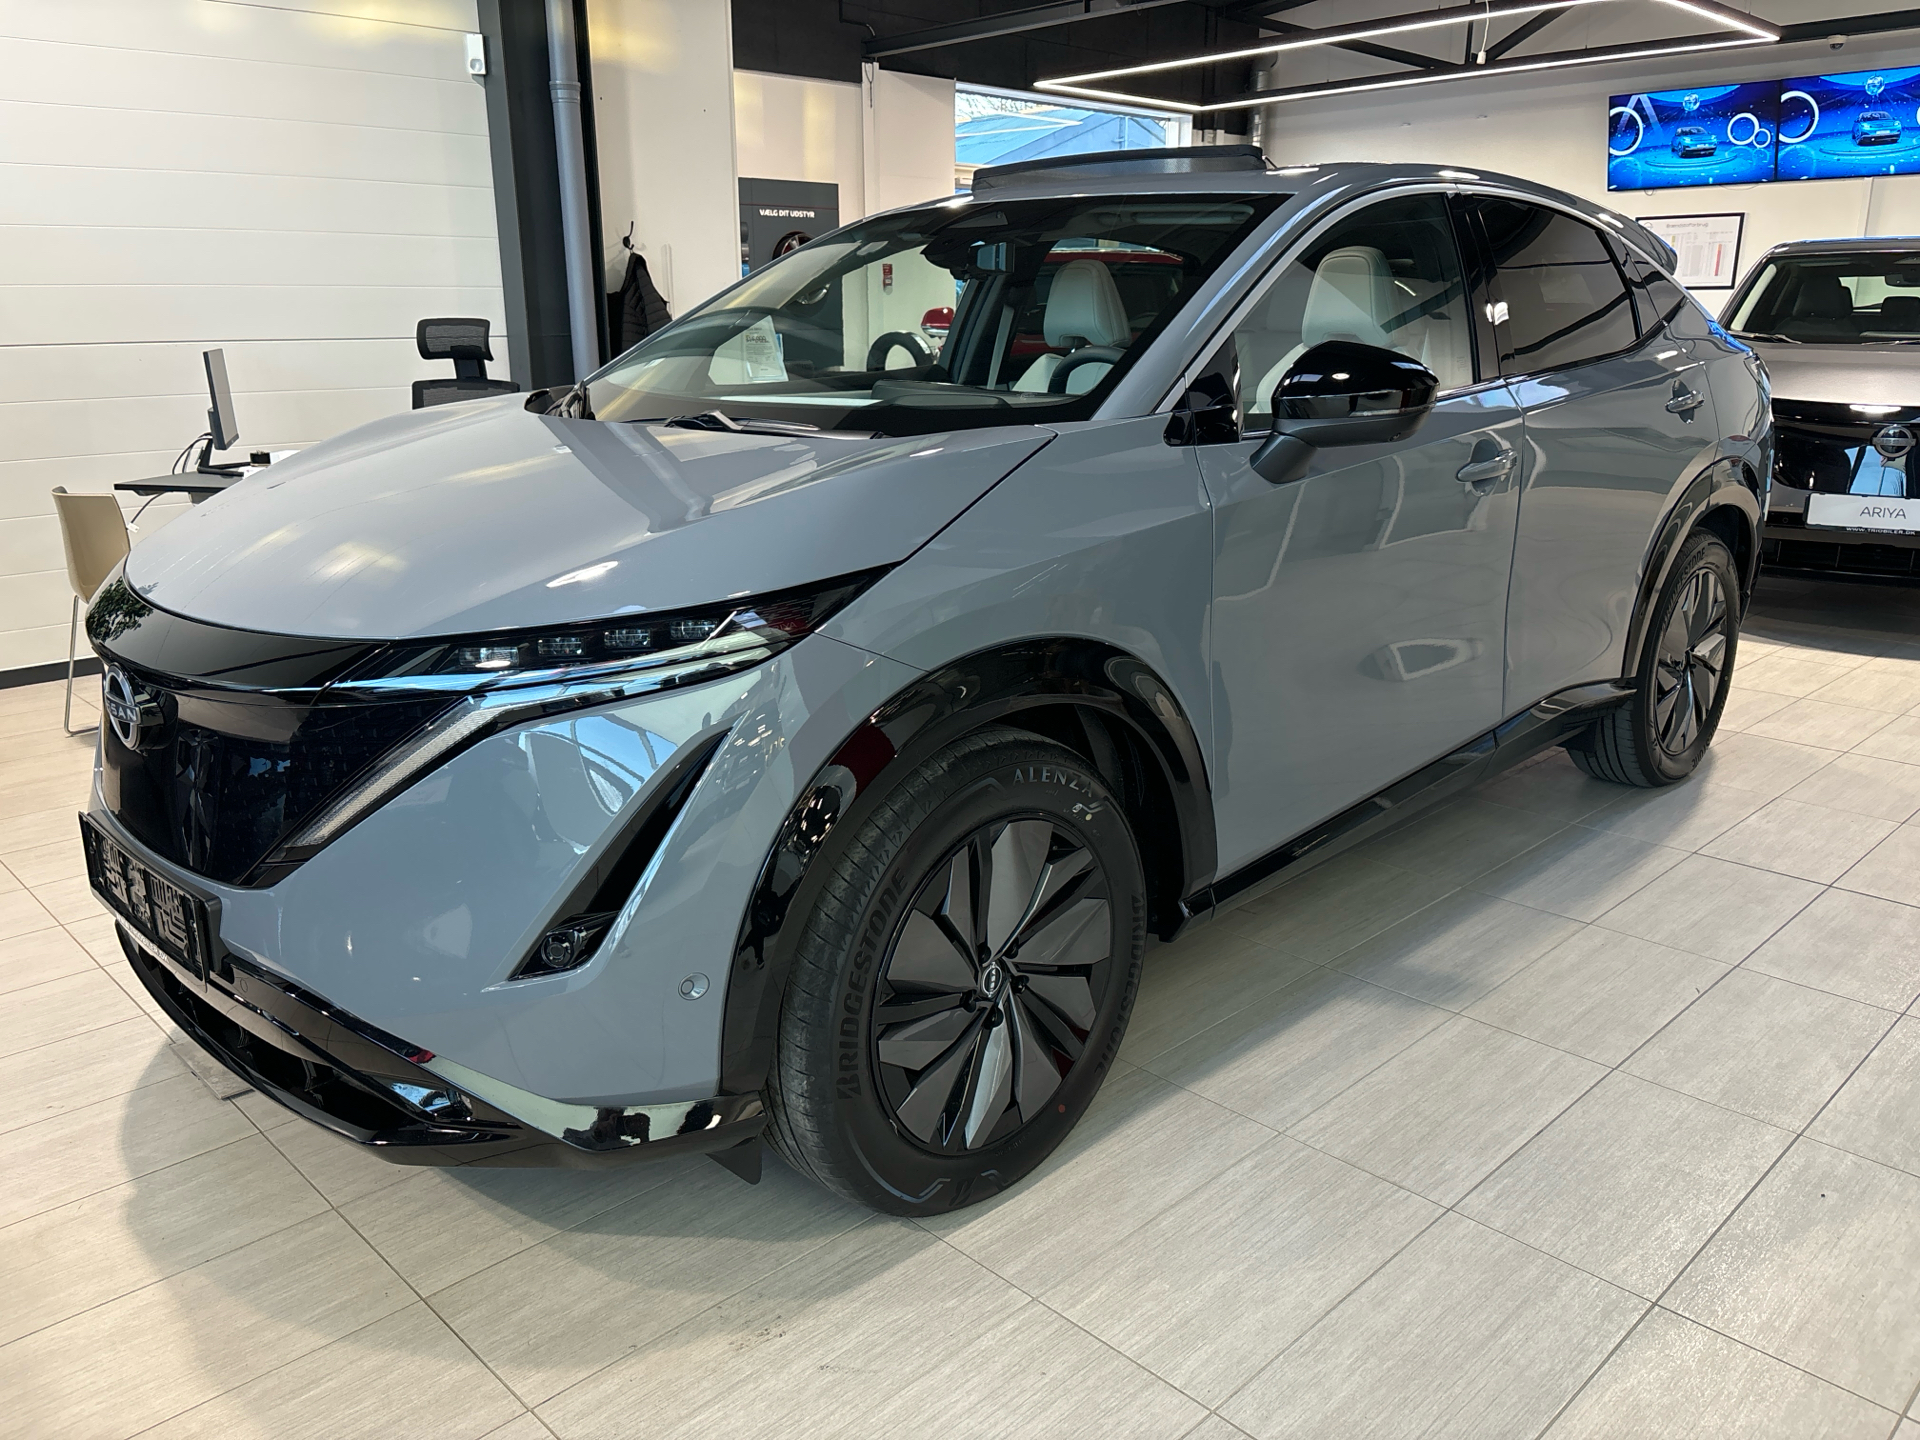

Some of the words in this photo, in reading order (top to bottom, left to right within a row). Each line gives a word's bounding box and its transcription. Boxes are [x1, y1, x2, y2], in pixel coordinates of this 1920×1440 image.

[759, 208, 779, 217] VÆLG
[779, 209, 789, 217] DIT
[790, 210, 815, 219] UDSTYR
[1860, 506, 1906, 519] ARIYA
[1013, 766, 1092, 798] ALENZA
[836, 867, 908, 1100] BRIDGESTONE
